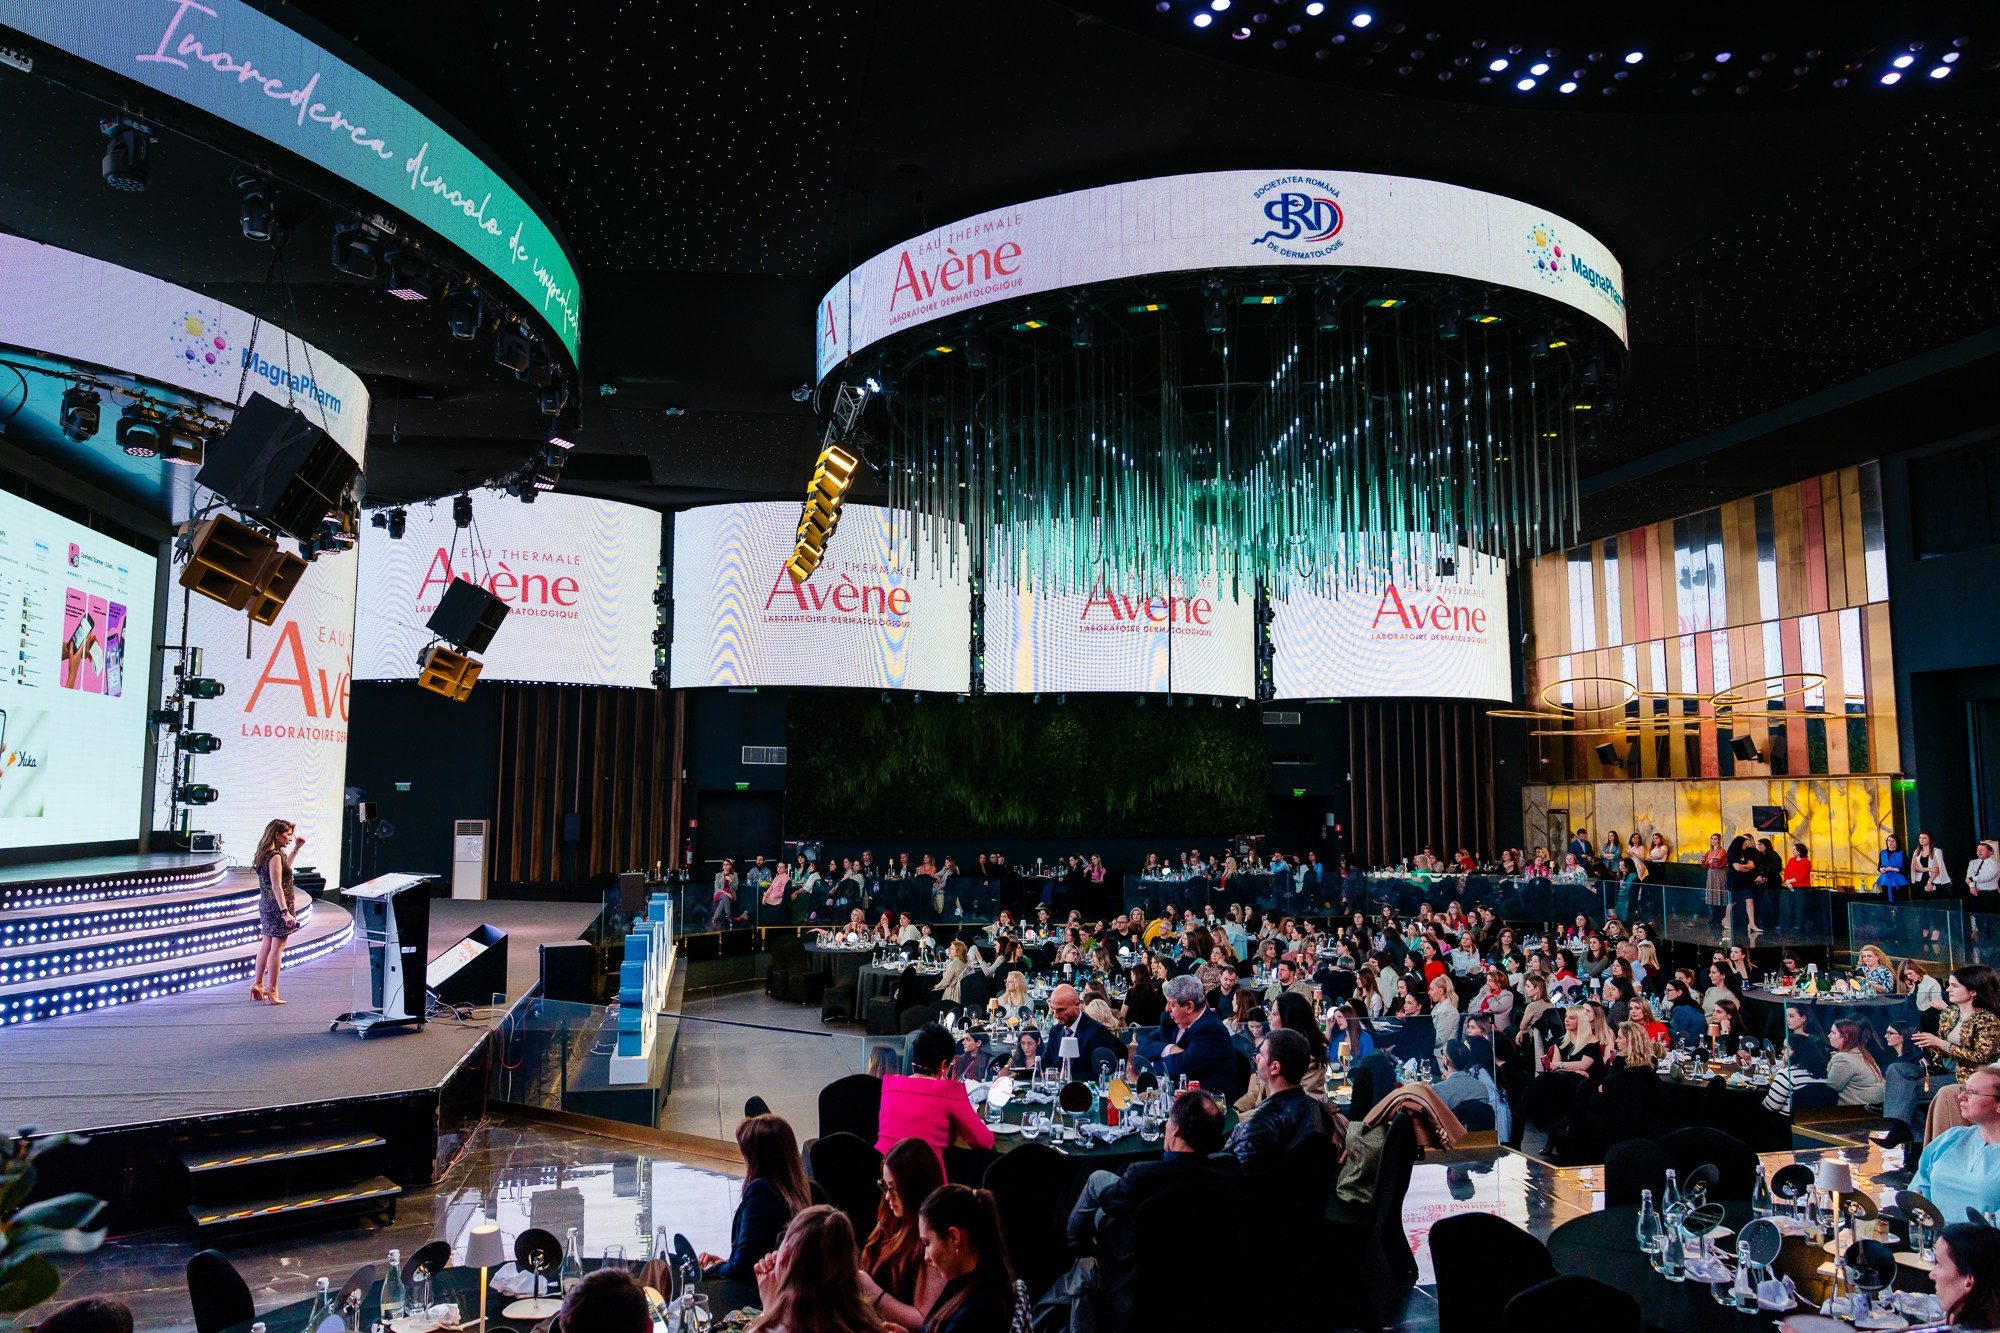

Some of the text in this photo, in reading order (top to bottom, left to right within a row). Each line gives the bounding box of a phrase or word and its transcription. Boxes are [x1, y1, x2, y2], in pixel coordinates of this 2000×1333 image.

[1253, 176, 1303, 199] SOCIETATEA
[919, 213, 1022, 256] EAU THERMALE
[1251, 193, 1343, 242] SRD
[510, 221, 528, 265] de
[1267, 239, 1344, 259] DE DERMATOLOGIE
[890, 241, 1022, 312] Avène
[889, 278, 1024, 326] LABORATOIRE DERMATOLOGIQUE
[241, 347, 342, 415] MagnaPharm
[416, 547, 579, 607] Avène
[461, 548, 581, 565] EAU THERMALE
[844, 562, 911, 577] THERMALE
[764, 560, 911, 616] Avène
[1081, 573, 1212, 625] Avène
[1372, 584, 1486, 633] Avène
[1408, 584, 1486, 599] EAU THERMALE
[318, 626, 345, 647] EAU
[763, 615, 911, 628] LABORATOIRE DERMATOLOGIQUE
[1079, 625, 1140, 633] LABORATOIRE
[243, 620, 351, 723] Avè
[241, 724, 334, 742] LABORATOIRE
[18, 751, 38, 768] Yuka
